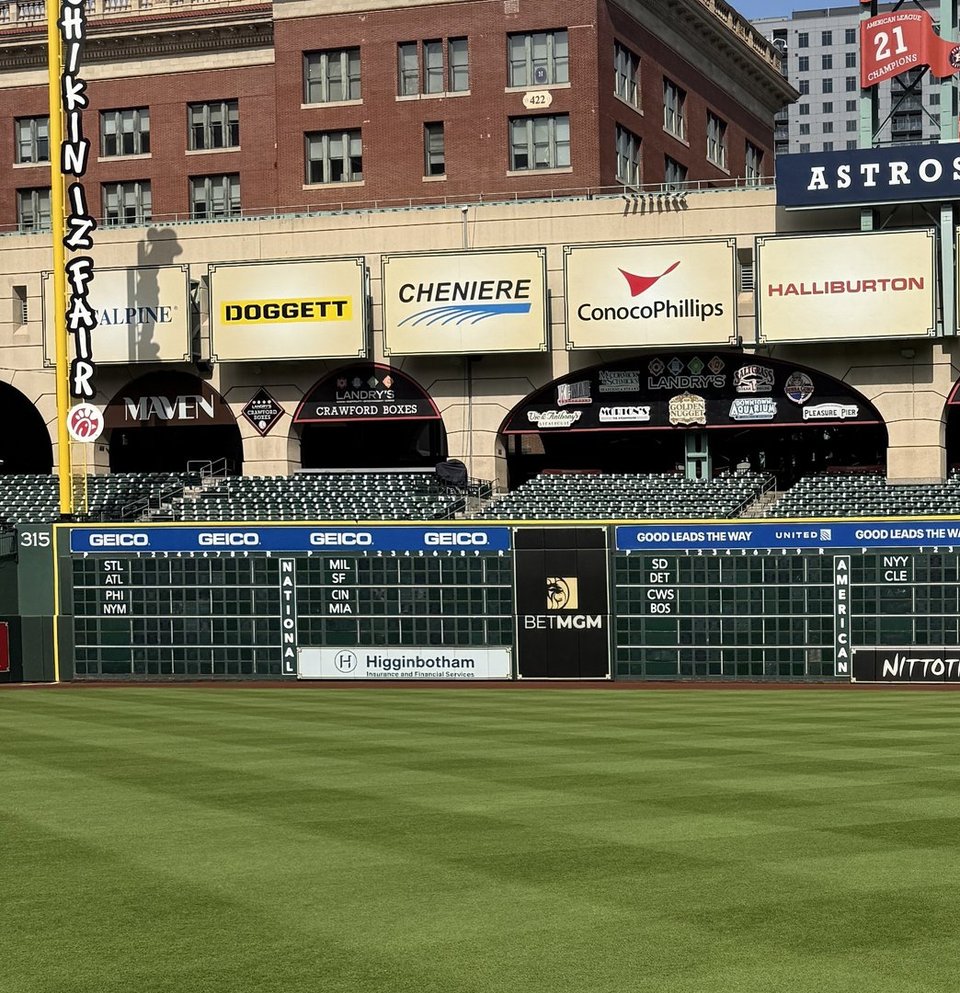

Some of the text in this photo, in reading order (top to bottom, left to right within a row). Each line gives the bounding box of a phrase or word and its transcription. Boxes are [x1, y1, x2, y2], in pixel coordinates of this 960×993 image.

[866, 13, 922, 29] AMERICAN LEAGUE
[873, 25, 908, 62] 21
[867, 53, 918, 81] CHAMPIONS
[62, 0, 86, 173] HIKIN
[530, 95, 546, 105] 422
[398, 279, 532, 303] CHENIERE
[767, 276, 925, 297] HALLIBURTON
[94, 305, 173, 326] ALPINE
[224, 300, 349, 321] DOGGETT
[577, 298, 725, 323] ConocoPhillips
[69, 261, 95, 396] FAIR
[647, 375, 726, 390] LANDRY'S
[335, 390, 395, 400] LANDRY'S
[122, 394, 215, 421] MAVEN
[315, 404, 418, 416] CRAWFORD BOXES
[601, 407, 649, 416] MORTON'S
[670, 403, 704, 411] GOLDEN
[731, 403, 776, 415] AQUARIUM
[804, 408, 857, 417] PLEASURE PIER
[89, 532, 488, 546] GEICO GEICO GEICO GEICO
[637, 531, 753, 542] GOOD LEADS THE WAY
[775, 531, 818, 539] UNITED
[855, 529, 888, 539] GOOD
[890, 529, 924, 539] LEADS
[926, 528, 946, 538] THE
[20, 532, 50, 547] 315
[104, 561, 124, 571] STL
[329, 559, 350, 570] MIL
[652, 559, 668, 569] SD
[883, 556, 908, 567] NYY
[105, 574, 124, 584] ATL
[332, 573, 346, 583] SF
[650, 573, 670, 583] DET
[884, 570, 907, 581] CLE
[106, 590, 124, 600] PHI
[331, 590, 349, 600] CIN
[647, 589, 674, 600] CWS
[103, 604, 127, 614] NYM
[329, 603, 352, 613] MIA
[650, 603, 671, 614] BOS
[282, 561, 295, 673] NATIONAL
[836, 559, 848, 673] AMERICAN
[524, 615, 602, 629] BETMGM
[366, 655, 475, 670] Higginbotham
